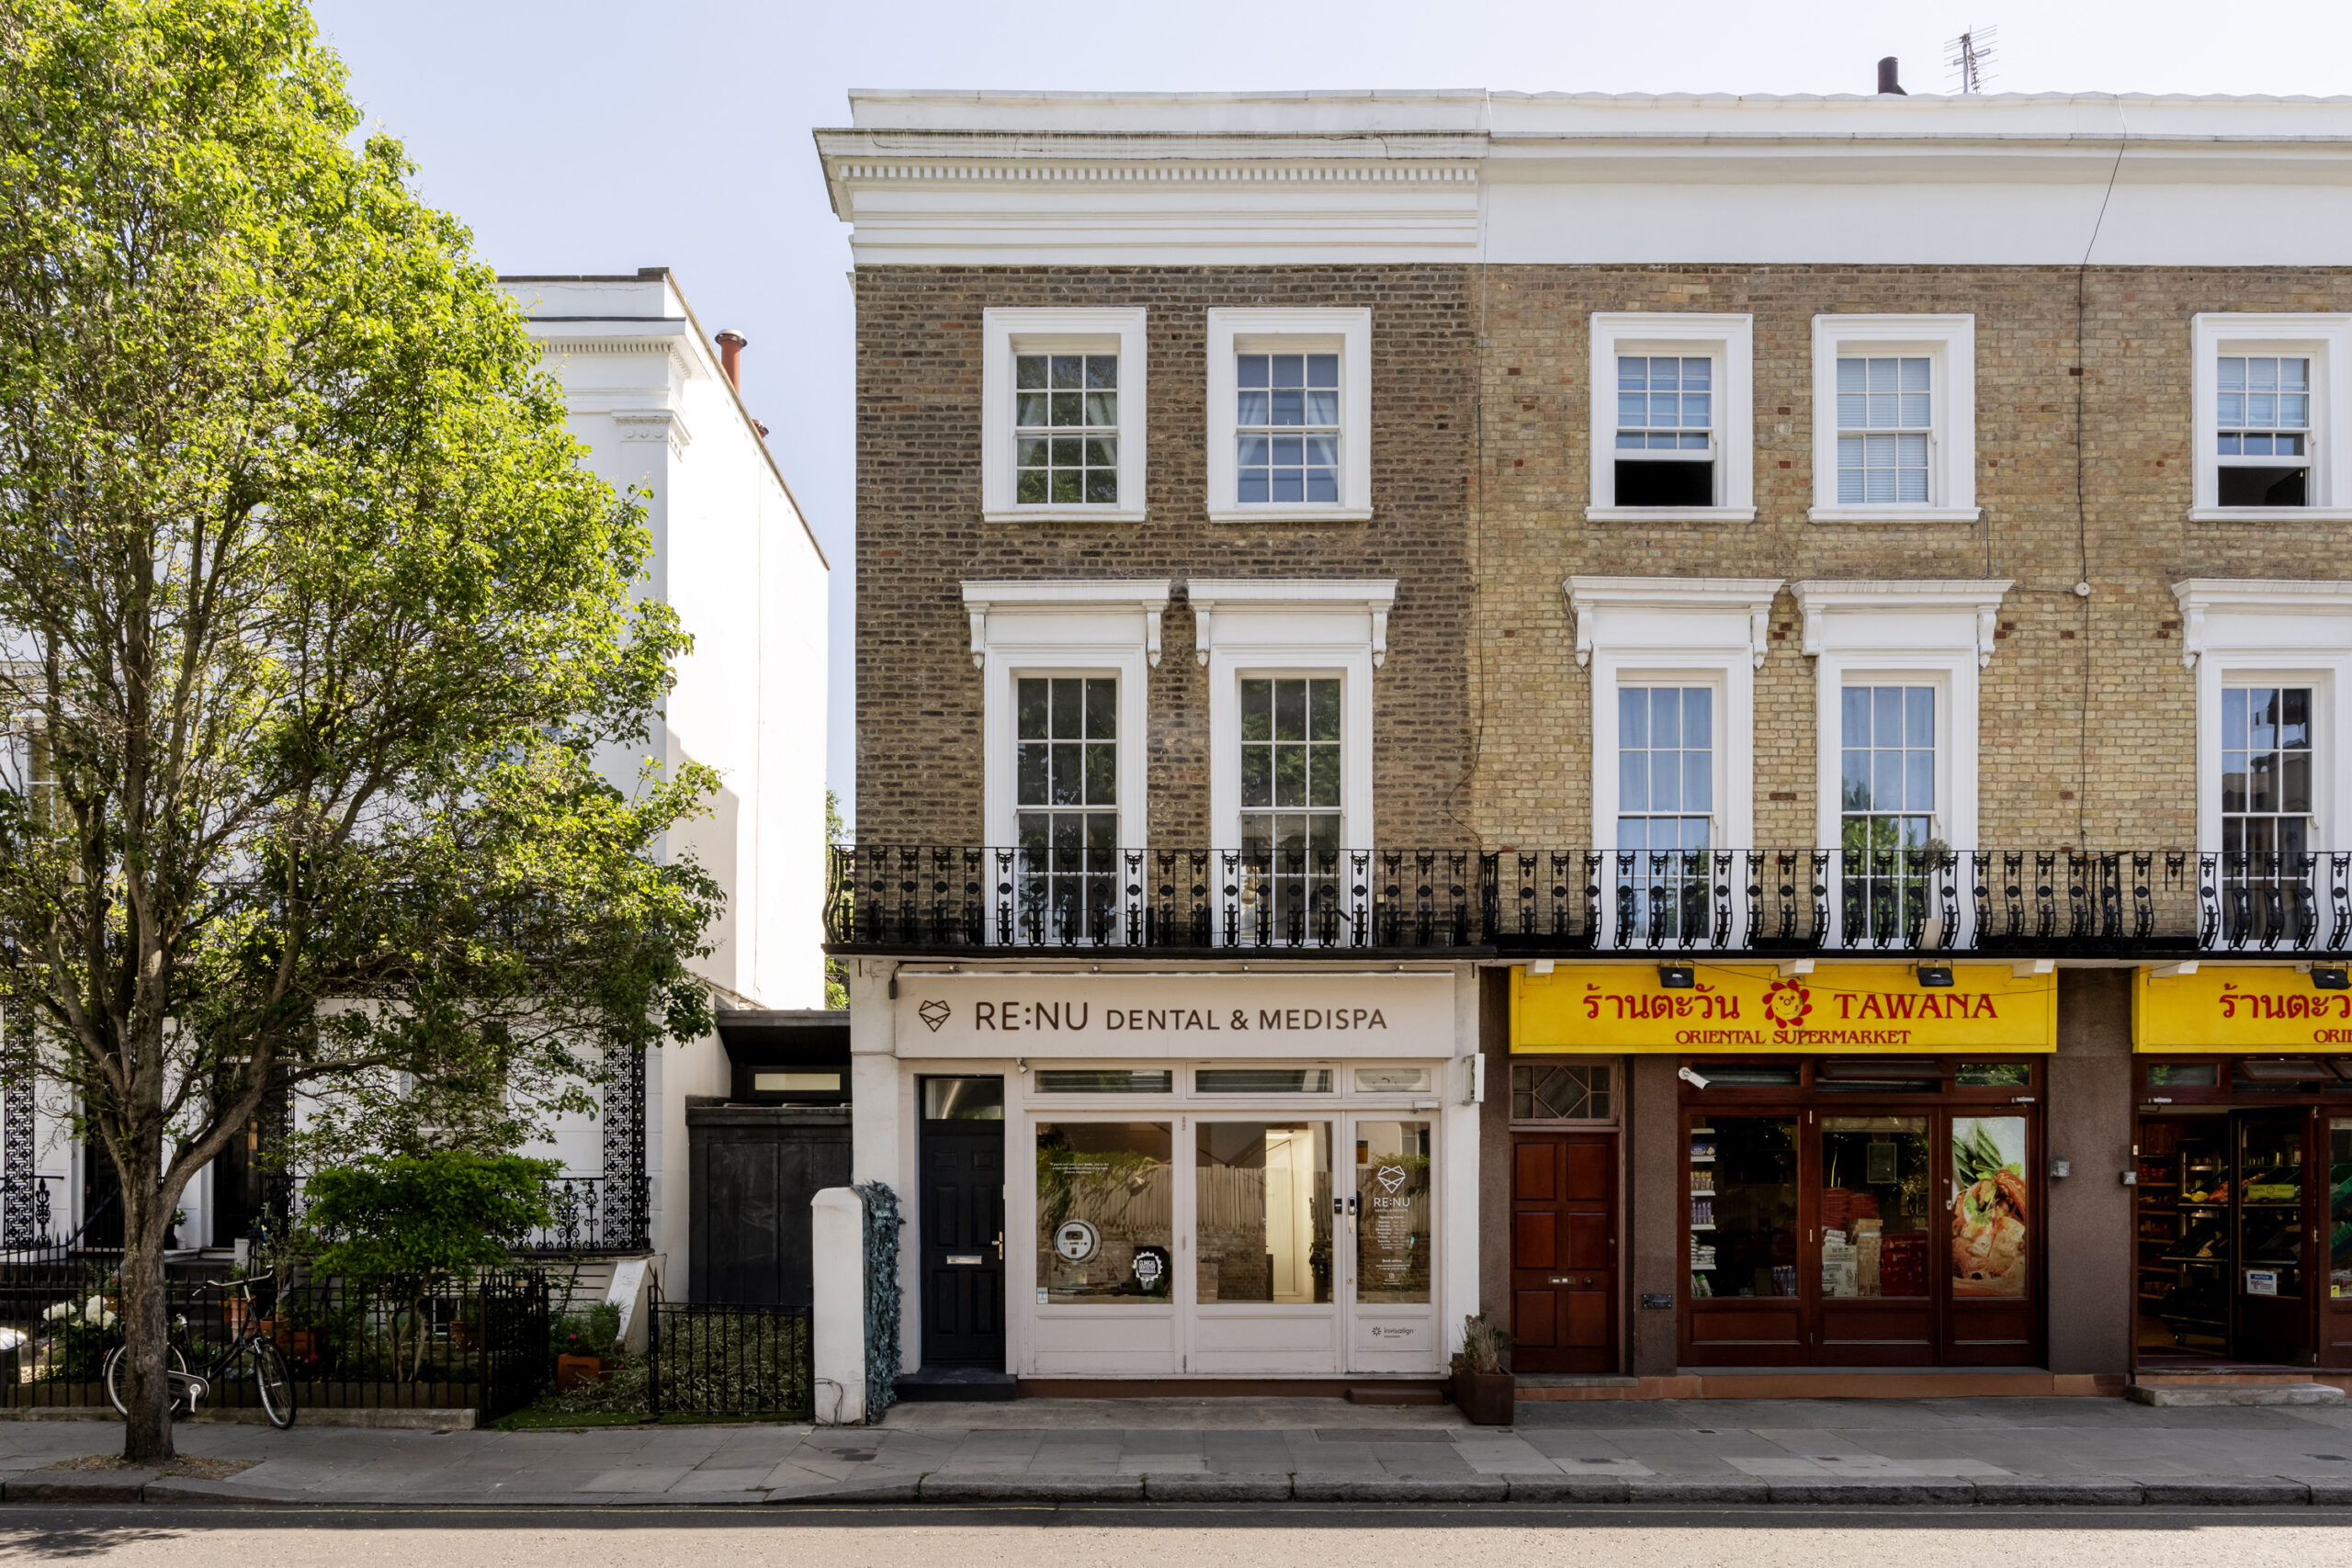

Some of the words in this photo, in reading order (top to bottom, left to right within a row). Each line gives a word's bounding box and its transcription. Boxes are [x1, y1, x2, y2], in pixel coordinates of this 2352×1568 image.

[1582, 982, 1741, 1020] ร้านตะวัน
[1833, 993, 1998, 1020] TAWANA
[2219, 982, 2352, 1020] ร้านตะว
[975, 1000, 1089, 1032] RE:NU
[1106, 1009, 1221, 1031] DENTAL
[1229, 1009, 1250, 1031] &
[1259, 1008, 1387, 1031] MEDISPA
[1675, 1030, 1766, 1044] ORIENTAL
[1772, 1030, 1912, 1044] SUPERMARKET
[1374, 1197, 1410, 1207] RE:NU
[1384, 1326, 1414, 1336] invisalign
